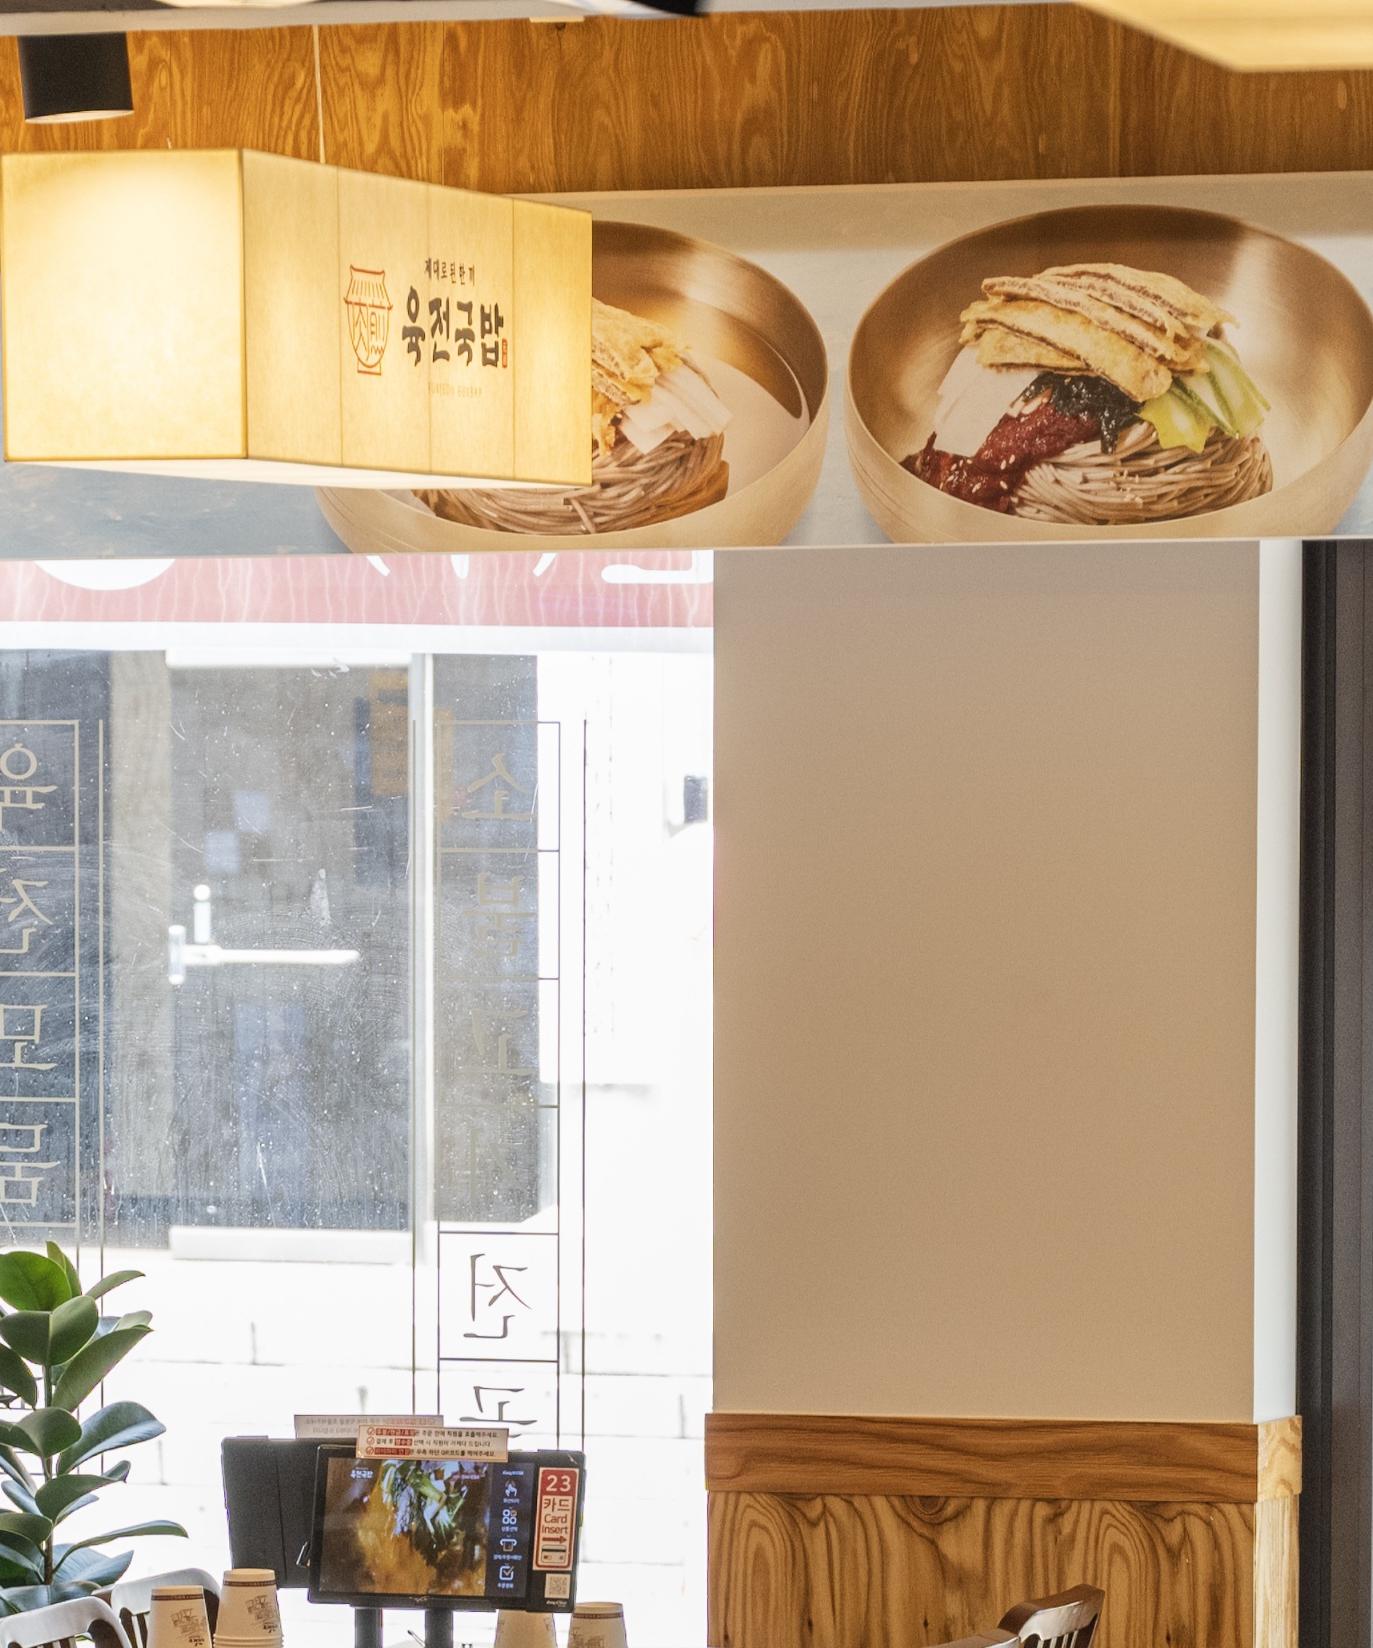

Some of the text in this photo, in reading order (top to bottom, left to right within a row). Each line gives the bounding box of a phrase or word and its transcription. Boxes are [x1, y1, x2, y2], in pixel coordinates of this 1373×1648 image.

[401, 284, 505, 369] 육전국밥
[545, 1474, 571, 1492] 23
[543, 1498, 571, 1512] 카드
[544, 1513, 568, 1524] Card
[541, 1524, 569, 1535] Insert
